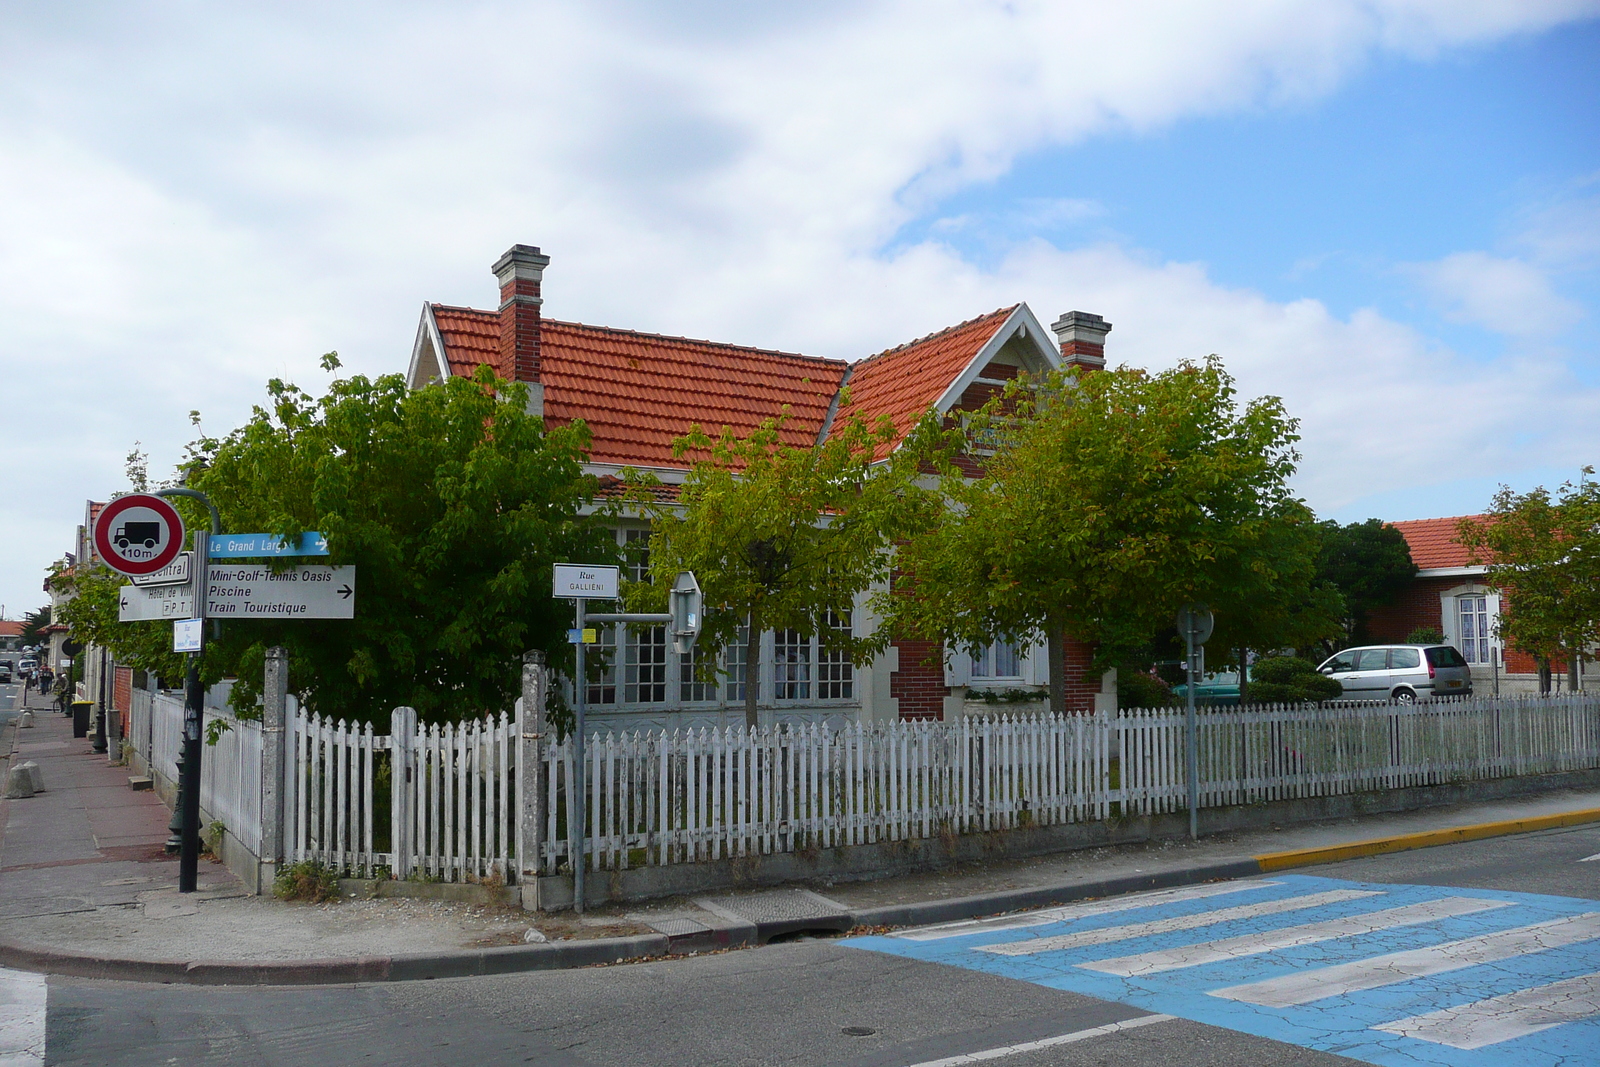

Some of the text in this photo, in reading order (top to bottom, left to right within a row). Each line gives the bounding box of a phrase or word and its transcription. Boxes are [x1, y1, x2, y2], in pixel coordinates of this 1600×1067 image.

[210, 541, 221, 552] Le
[228, 540, 255, 552] Grand
[152, 561, 186, 577] entral
[209, 570, 332, 582] Mini-Golf-Tennis Oasis
[579, 571, 595, 580] Rue
[168, 586, 177, 598] de
[180, 585, 192, 597] Vill
[208, 585, 252, 597] Piscine
[208, 601, 307, 616] Train Touristique
